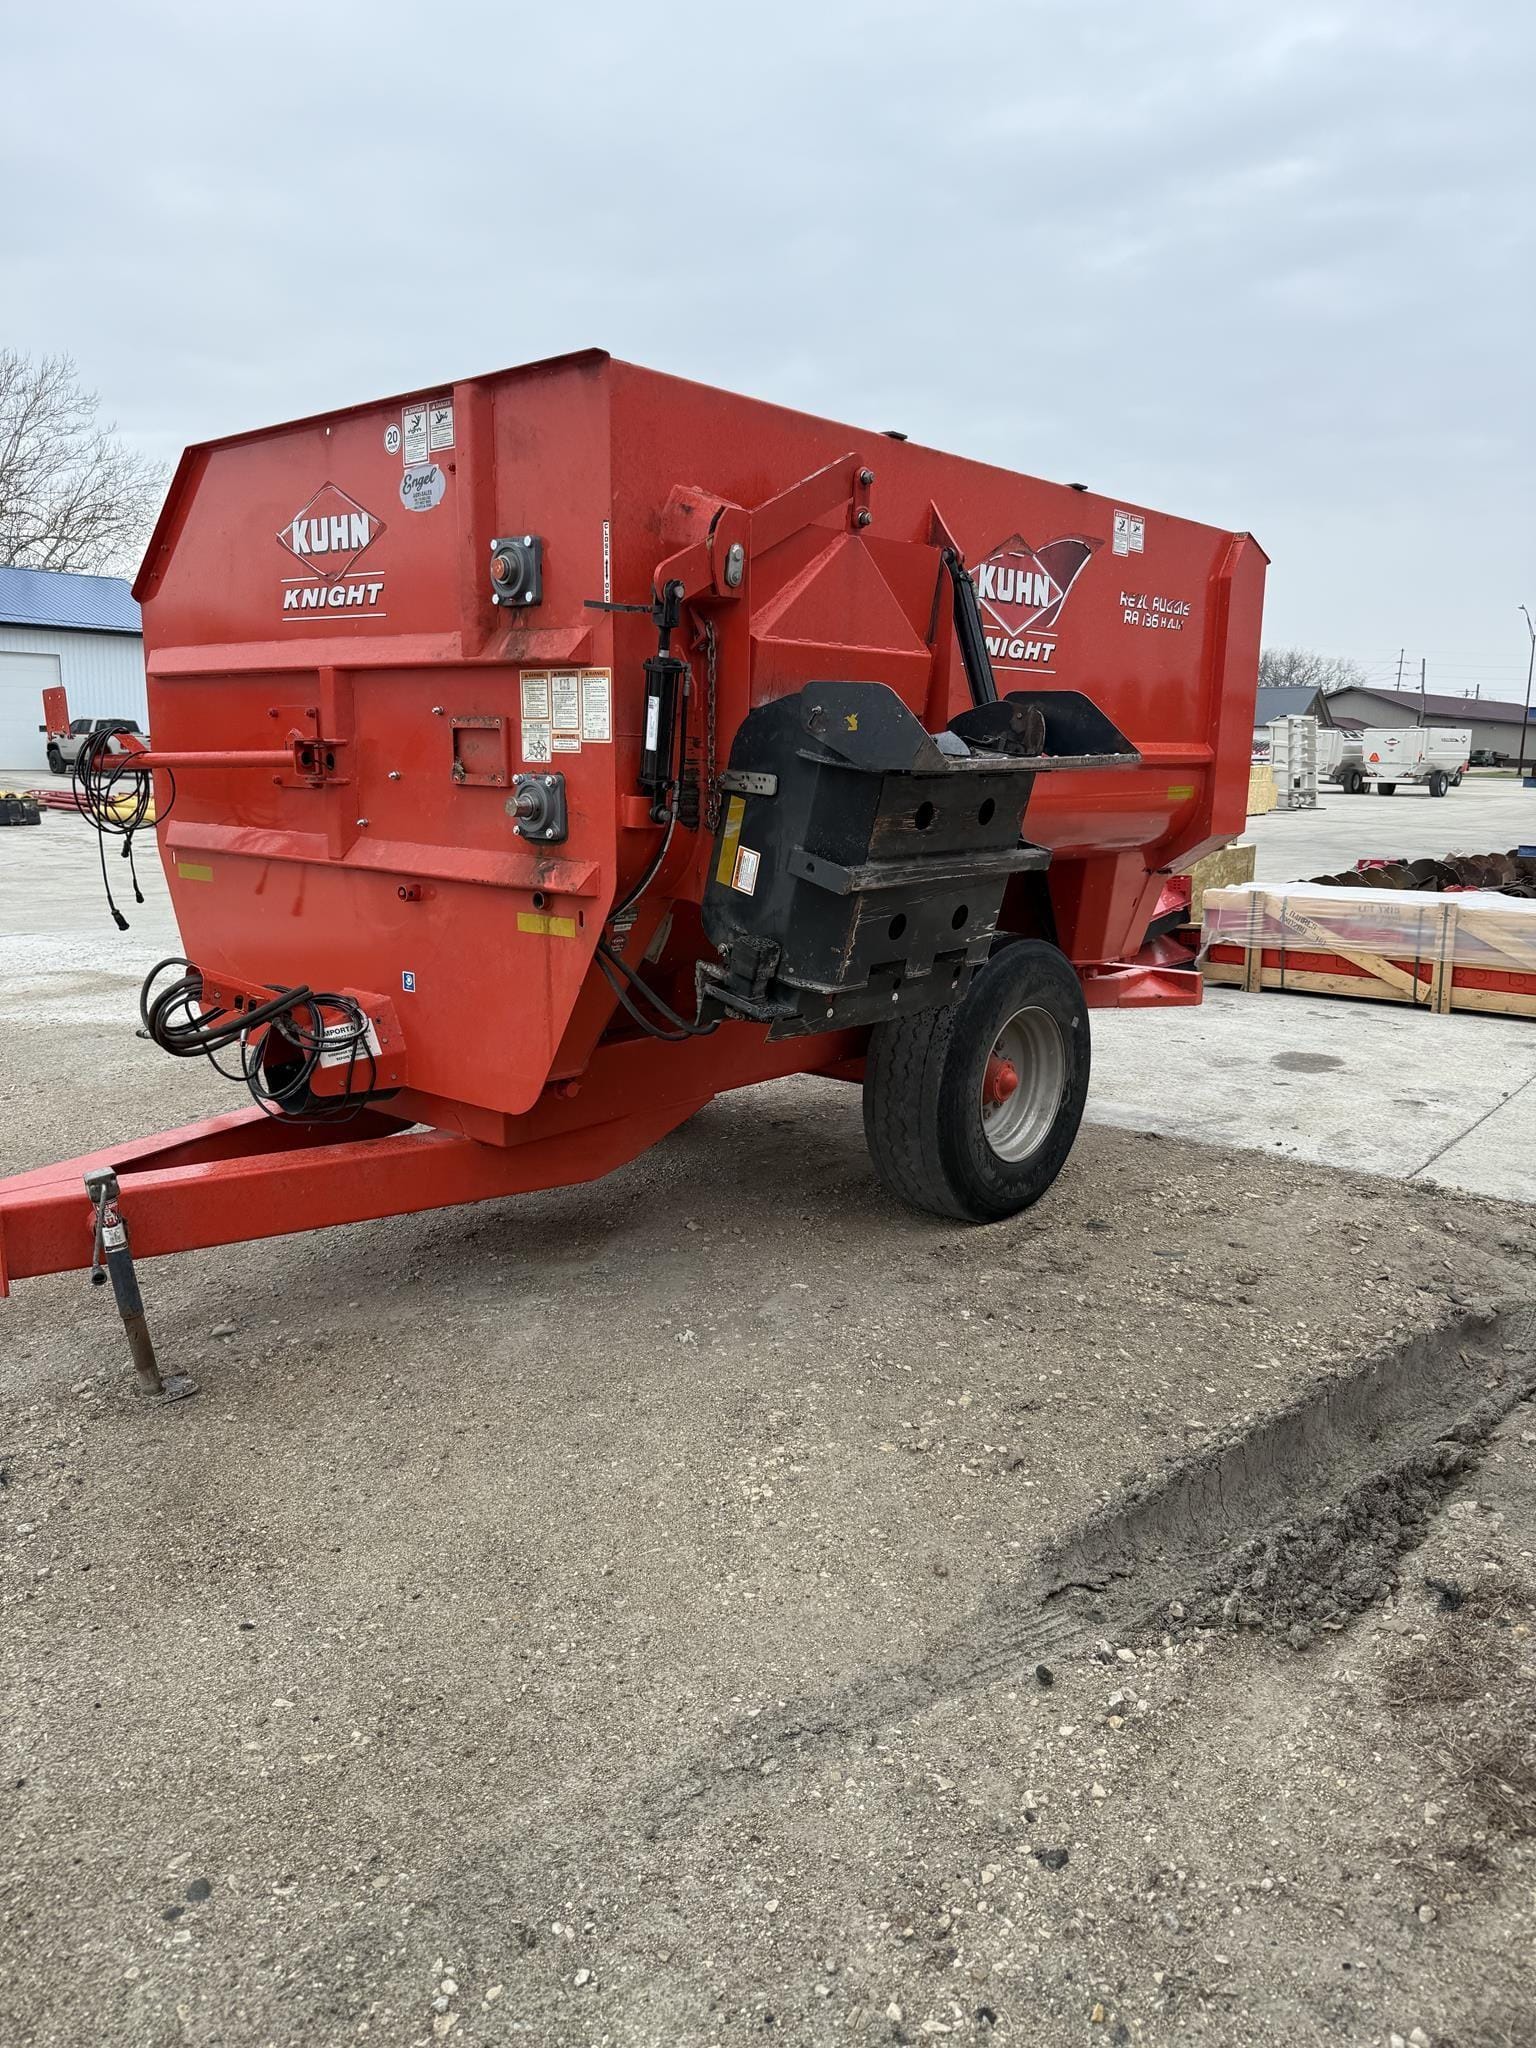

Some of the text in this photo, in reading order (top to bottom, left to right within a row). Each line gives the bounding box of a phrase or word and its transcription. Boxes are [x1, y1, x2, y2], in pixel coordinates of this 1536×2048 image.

[387, 430, 399, 445] 20
[402, 467, 437, 495] Engel
[292, 512, 371, 555] KUHN
[283, 582, 384, 610] KNIGHT
[978, 563, 1050, 608] KUHN
[1124, 609, 1139, 625] RA
[985, 636, 1056, 663] NIGHT
